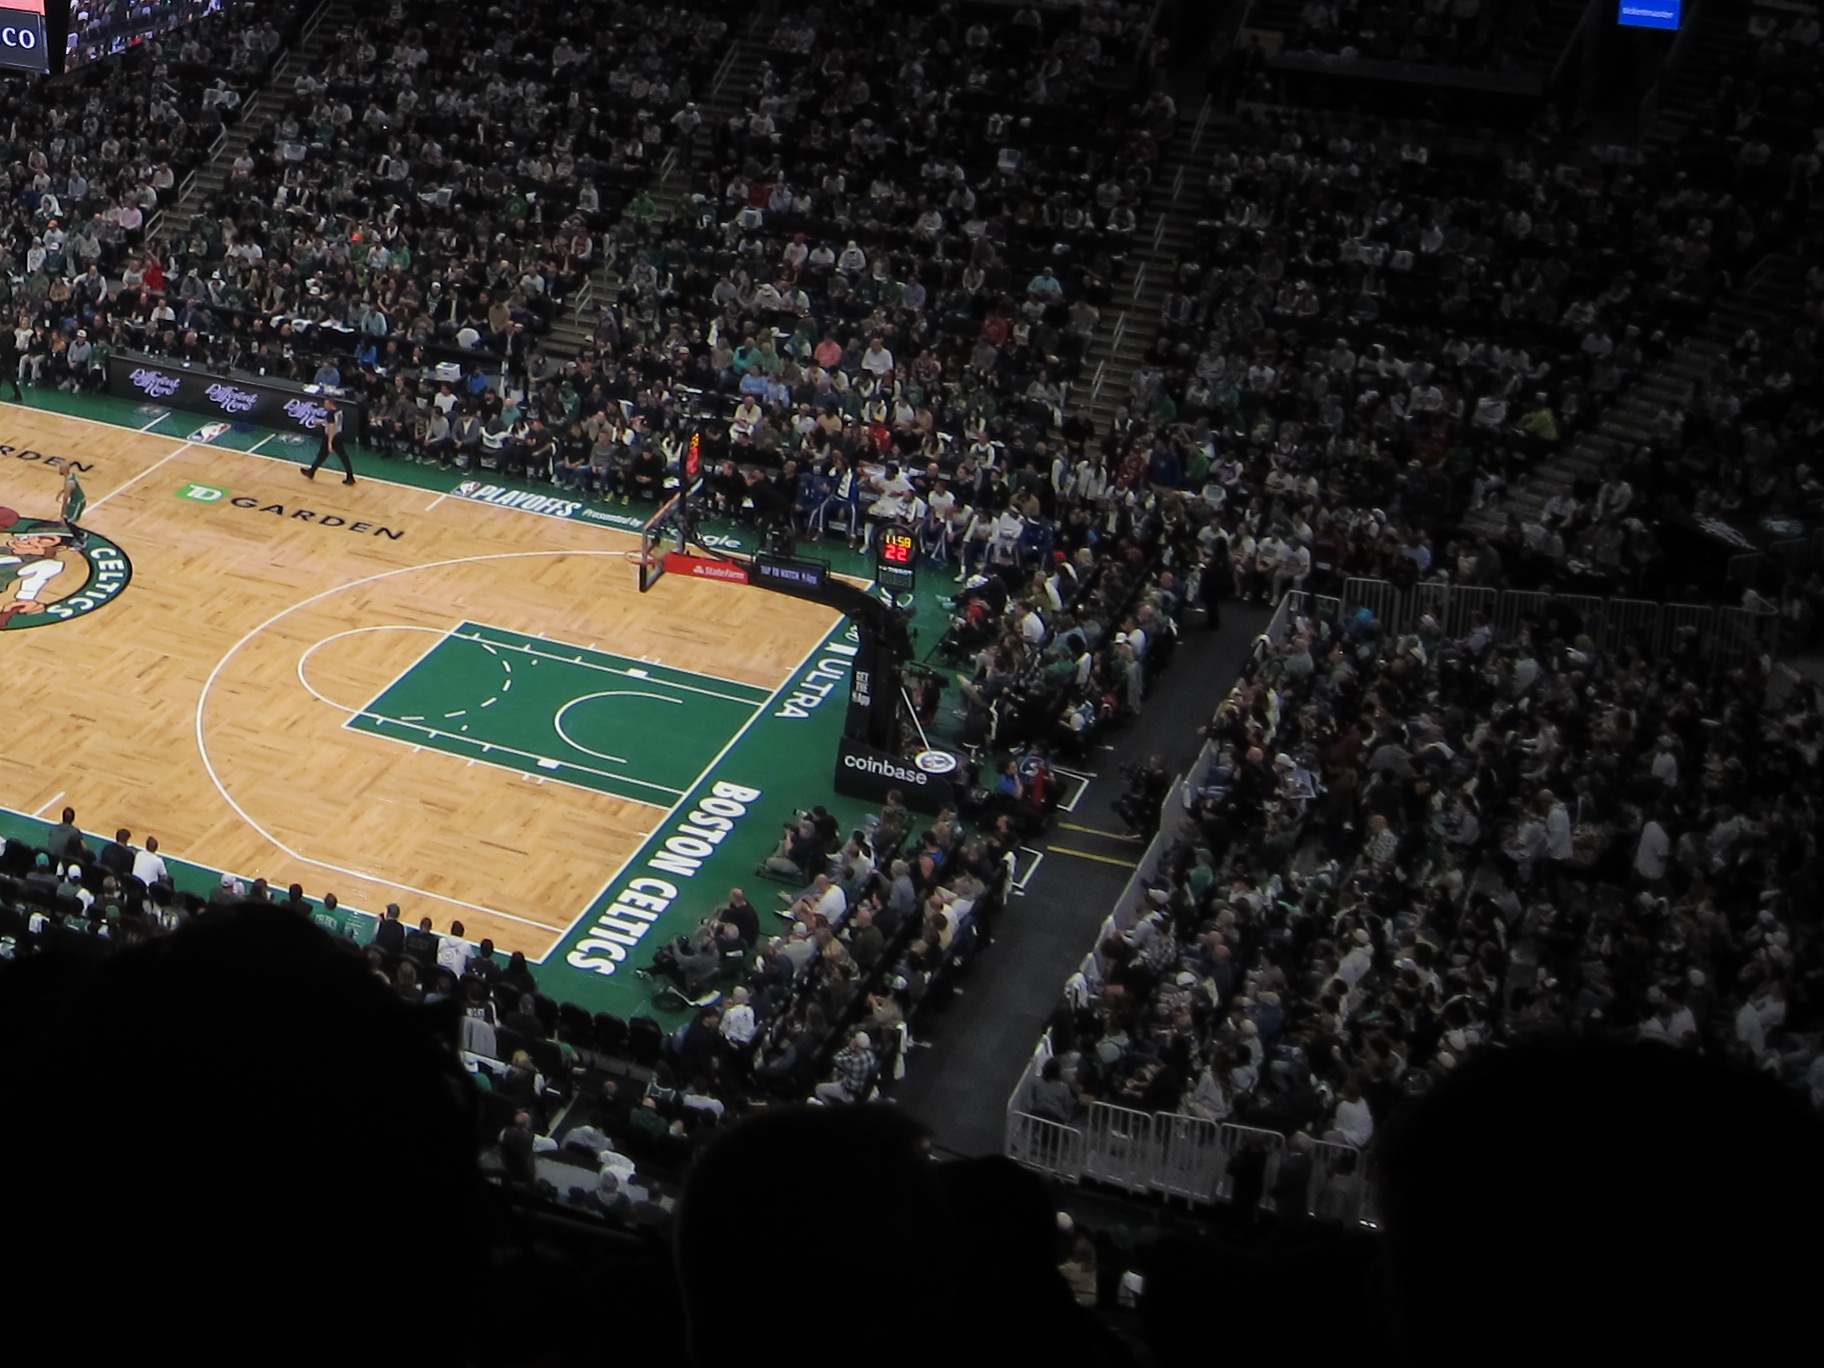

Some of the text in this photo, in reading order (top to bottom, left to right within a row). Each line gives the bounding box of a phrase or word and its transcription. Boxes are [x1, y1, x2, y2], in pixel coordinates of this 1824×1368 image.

[186, 484, 406, 541] TD GARDEN
[474, 485, 583, 518] PLAYOFFS
[884, 545, 909, 562] 22
[885, 536, 911, 548] 11:58
[46, 546, 125, 620] CELTICS
[773, 658, 853, 719] ULTRA
[843, 754, 928, 786] coinbase
[565, 780, 763, 976] BOSTON CELTICS
